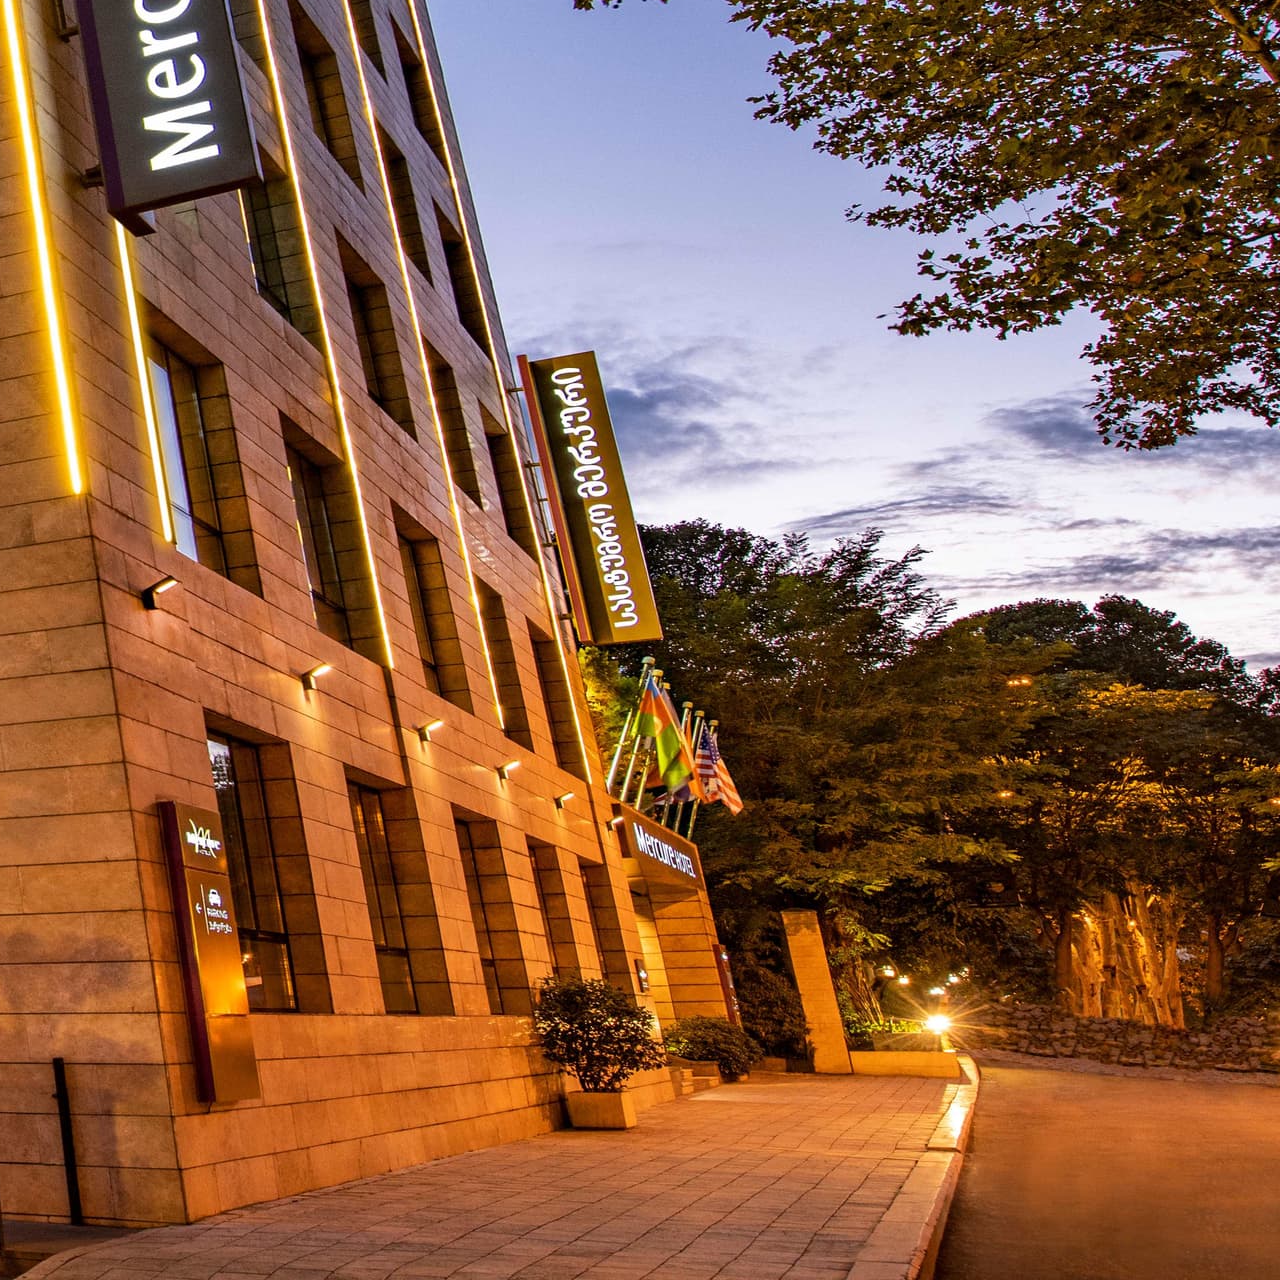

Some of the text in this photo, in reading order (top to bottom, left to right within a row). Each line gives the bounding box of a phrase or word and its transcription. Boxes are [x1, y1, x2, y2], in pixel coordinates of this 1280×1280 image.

[550, 366, 639, 628] სასტუმრო მერკური
[632, 821, 677, 870] Mercure
